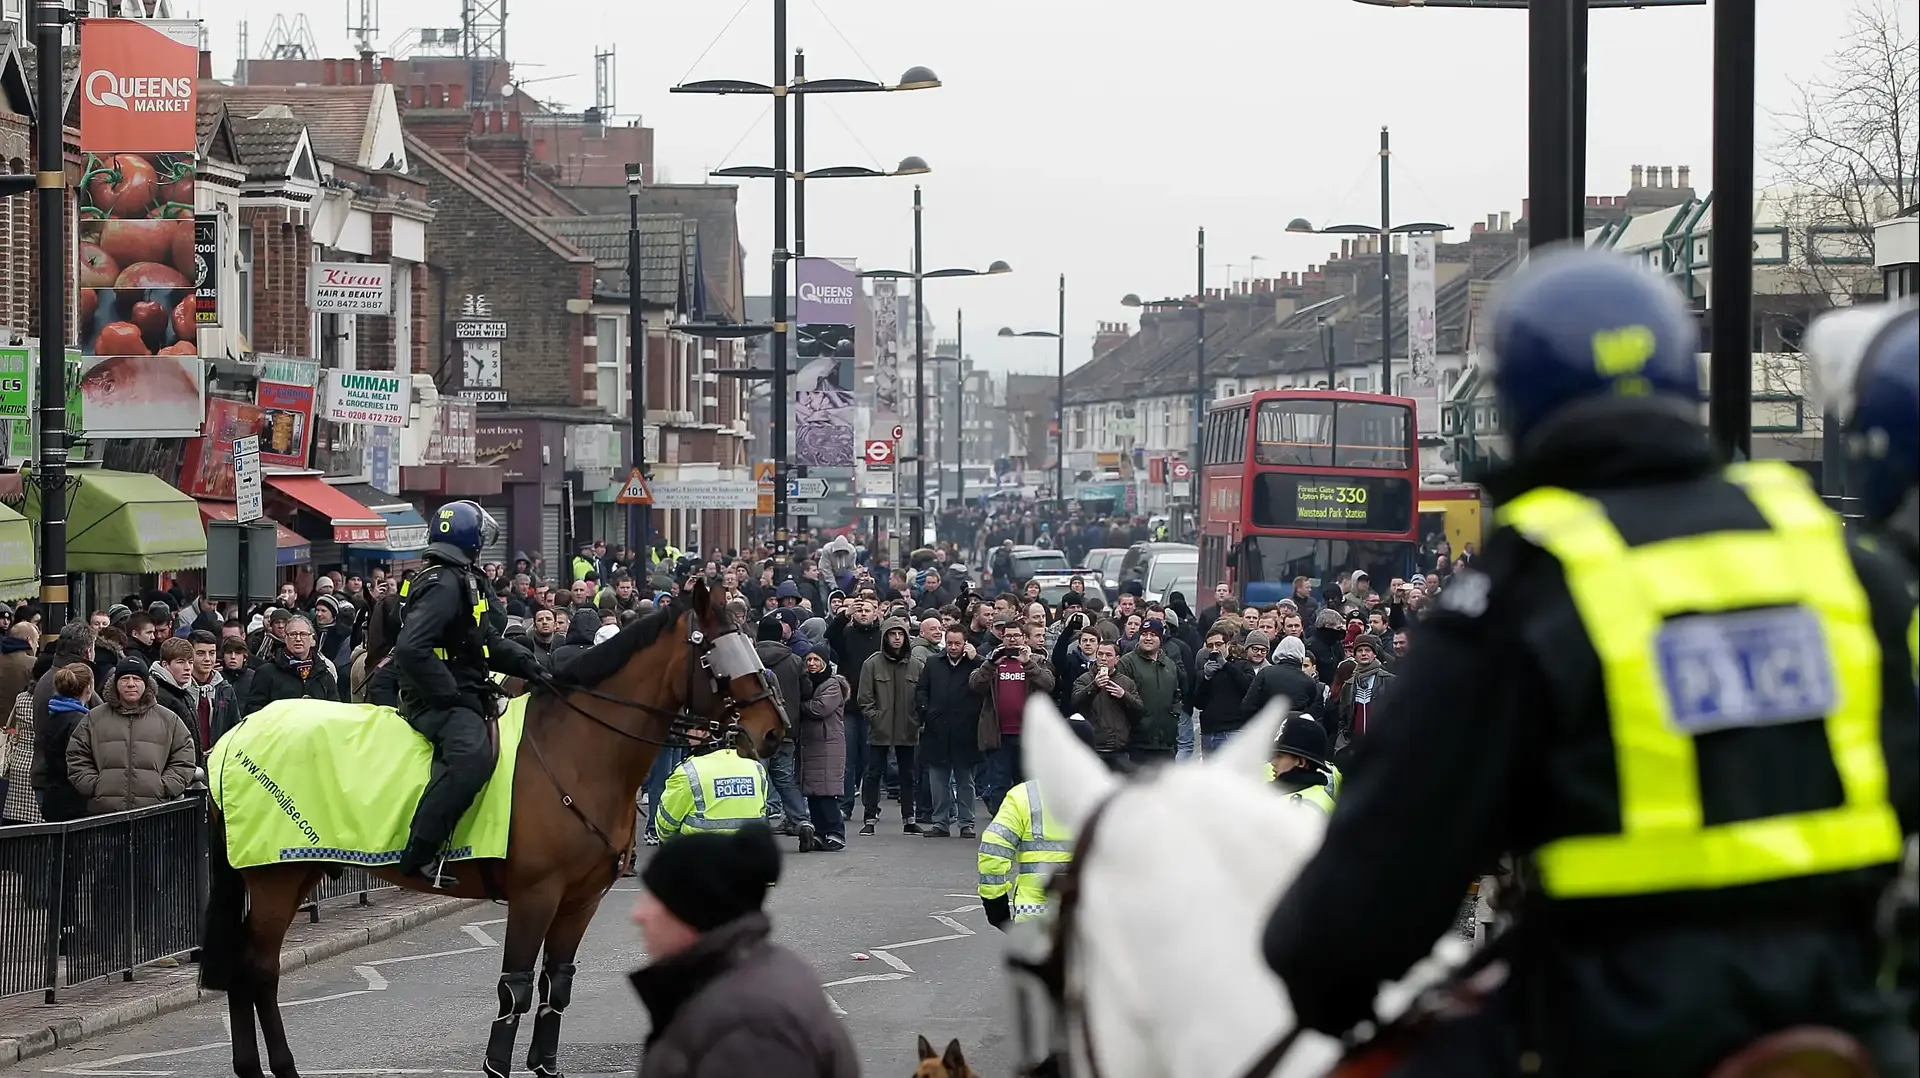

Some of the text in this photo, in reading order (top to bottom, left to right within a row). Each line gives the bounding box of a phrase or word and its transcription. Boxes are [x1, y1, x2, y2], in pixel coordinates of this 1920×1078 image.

[85, 69, 192, 111] QUEENS
[134, 99, 191, 112] MARKET
[319, 268, 382, 286] Kiran
[317, 289, 383, 299] HAIR & BEAUTY
[799, 282, 853, 303] QUEENS
[337, 300, 358, 308] 8472
[360, 301, 383, 309] 3887
[824, 297, 853, 305] MARKET
[491, 361, 498, 369] 3
[491, 371, 498, 379] 4
[341, 374, 400, 393] UMMAH
[347, 390, 391, 401] HALAL MEAT
[485, 392, 496, 401] DO
[498, 392, 506, 401] IT
[345, 399, 384, 410] GROCERIES
[385, 403, 399, 412] LTD
[332, 409, 346, 418] TEL:
[348, 411, 367, 421] 0208
[368, 413, 382, 422] 472
[893, 426, 901, 438] C
[627, 487, 643, 496] 101
[1297, 485, 1335, 493] Forest Gate
[1298, 492, 1334, 501] Upton Park
[1336, 487, 1367, 503] 330
[439, 509, 455, 519] MP
[791, 504, 815, 514] School
[1297, 506, 1367, 519] Wanstead Park Station
[1000, 672, 1026, 681] SBOBE
[715, 778, 752, 786] METROPOLITAN
[717, 784, 753, 797] POLICE
